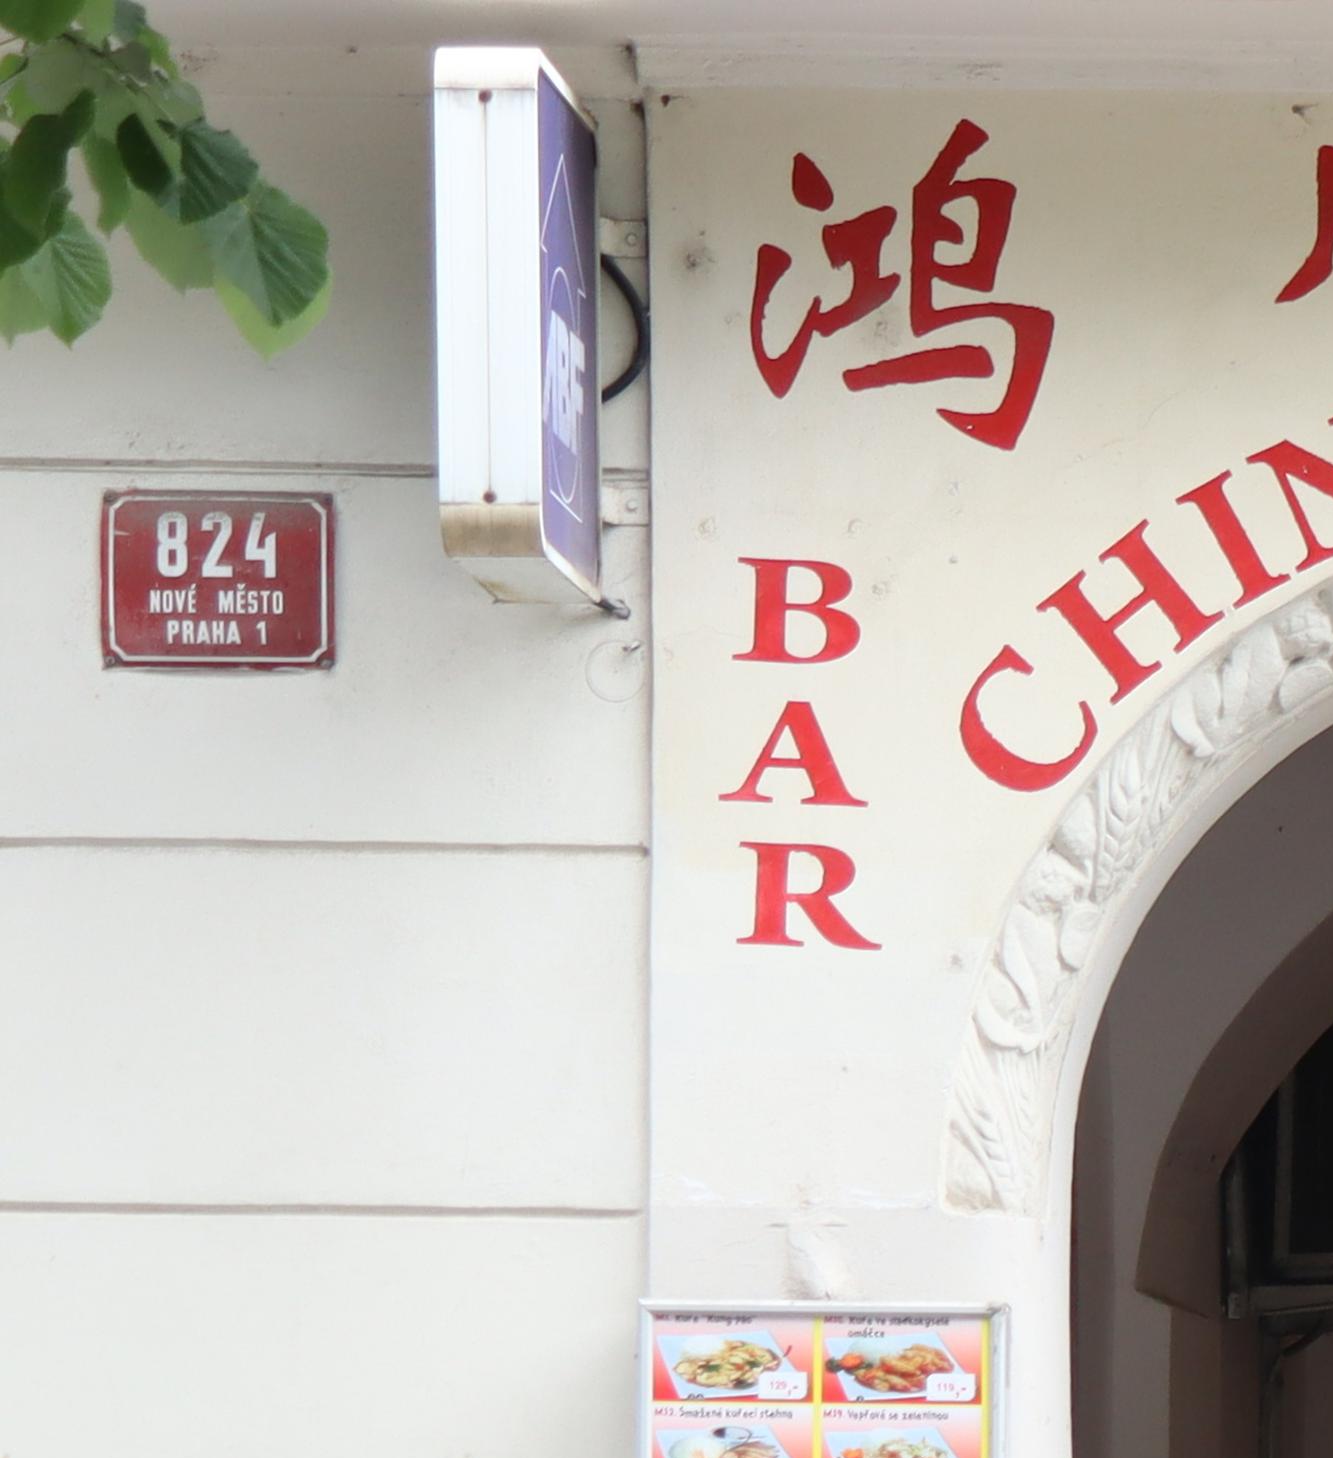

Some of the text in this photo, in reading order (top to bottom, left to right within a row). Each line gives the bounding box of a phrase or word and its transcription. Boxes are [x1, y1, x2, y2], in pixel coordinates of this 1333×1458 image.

[157, 511, 277, 579] 824
[150, 583, 284, 616] NOVÉ MĚSTO
[166, 620, 268, 646] PRAHA 1
[719, 556, 882, 950] BAR
